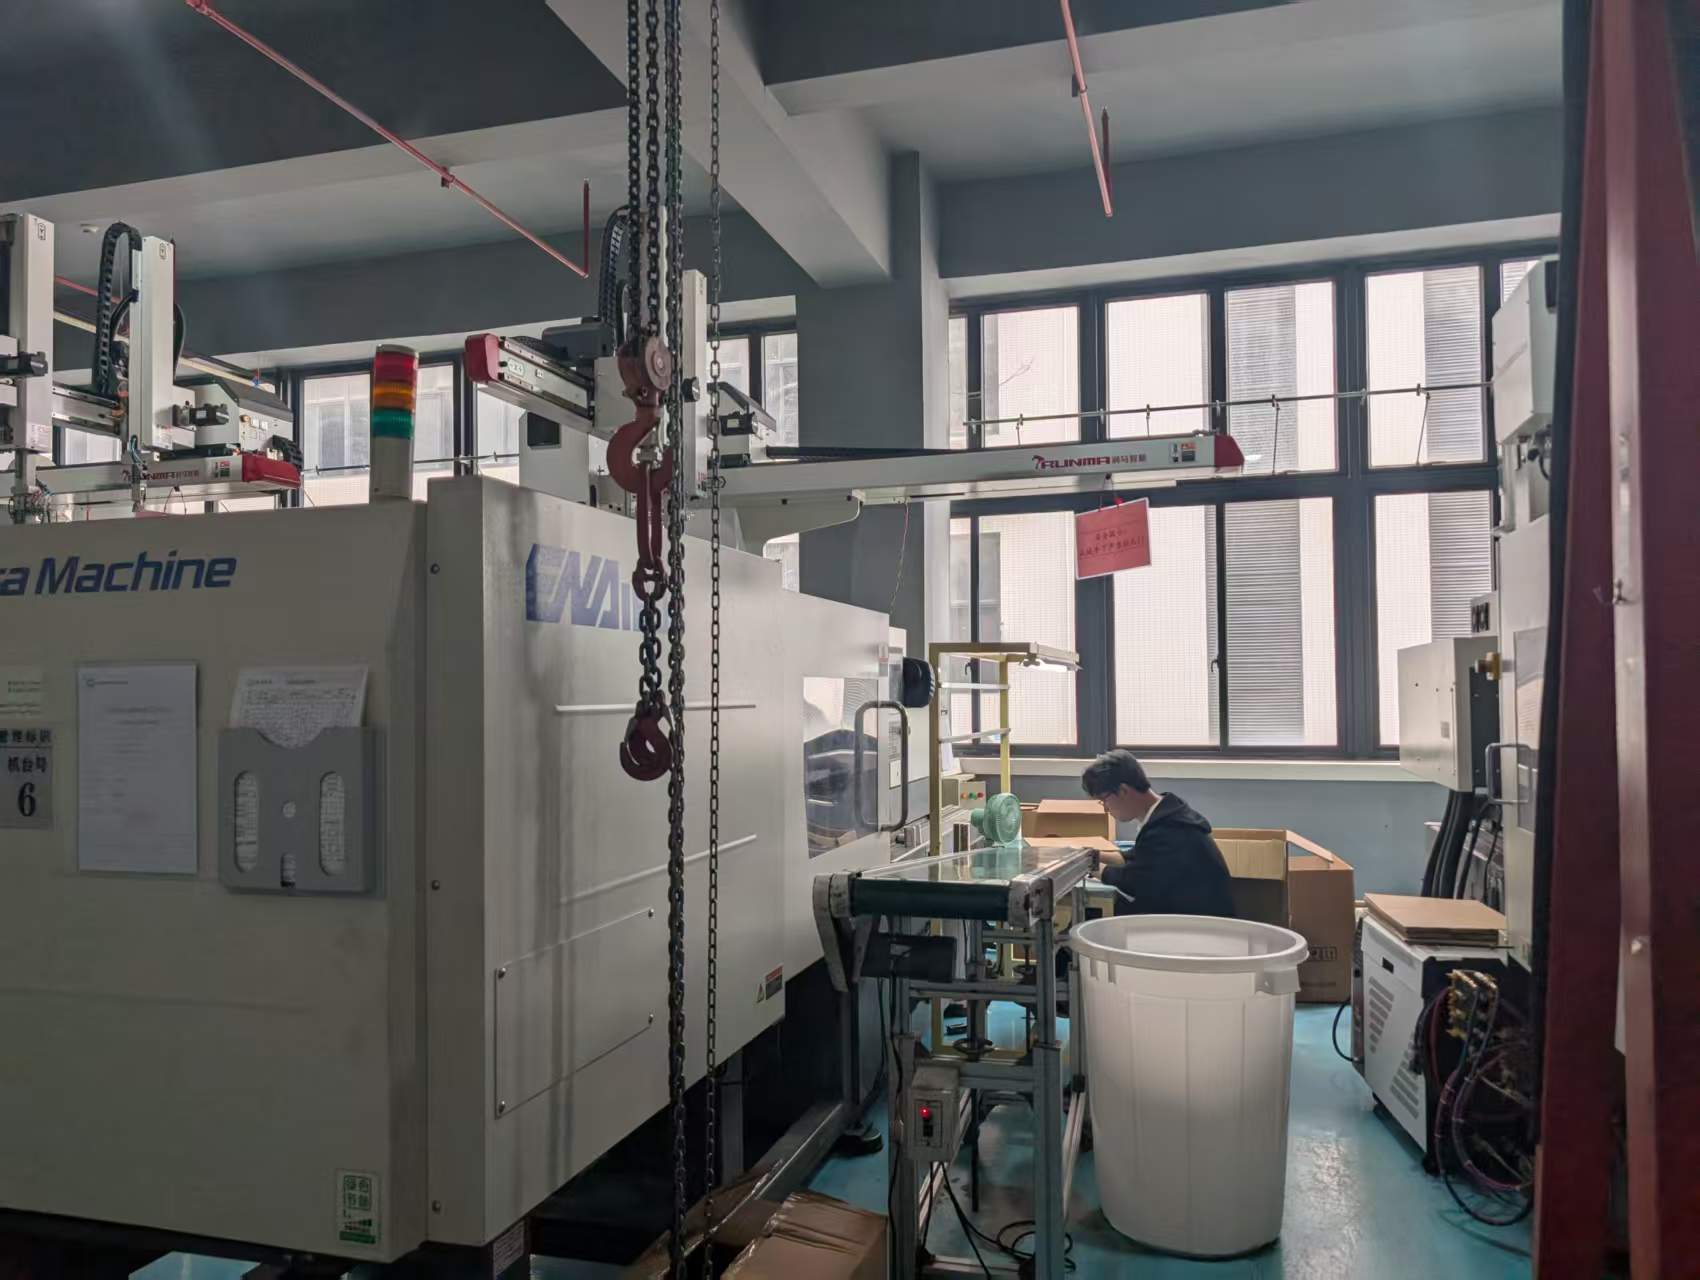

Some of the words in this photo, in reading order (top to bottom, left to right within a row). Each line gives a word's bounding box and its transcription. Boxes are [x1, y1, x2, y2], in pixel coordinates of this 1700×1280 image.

[1040, 456, 1111, 469] RUNMA
[0, 567, 30, 597] a
[35, 550, 237, 595] Machine
[18, 782, 36, 817] 6
